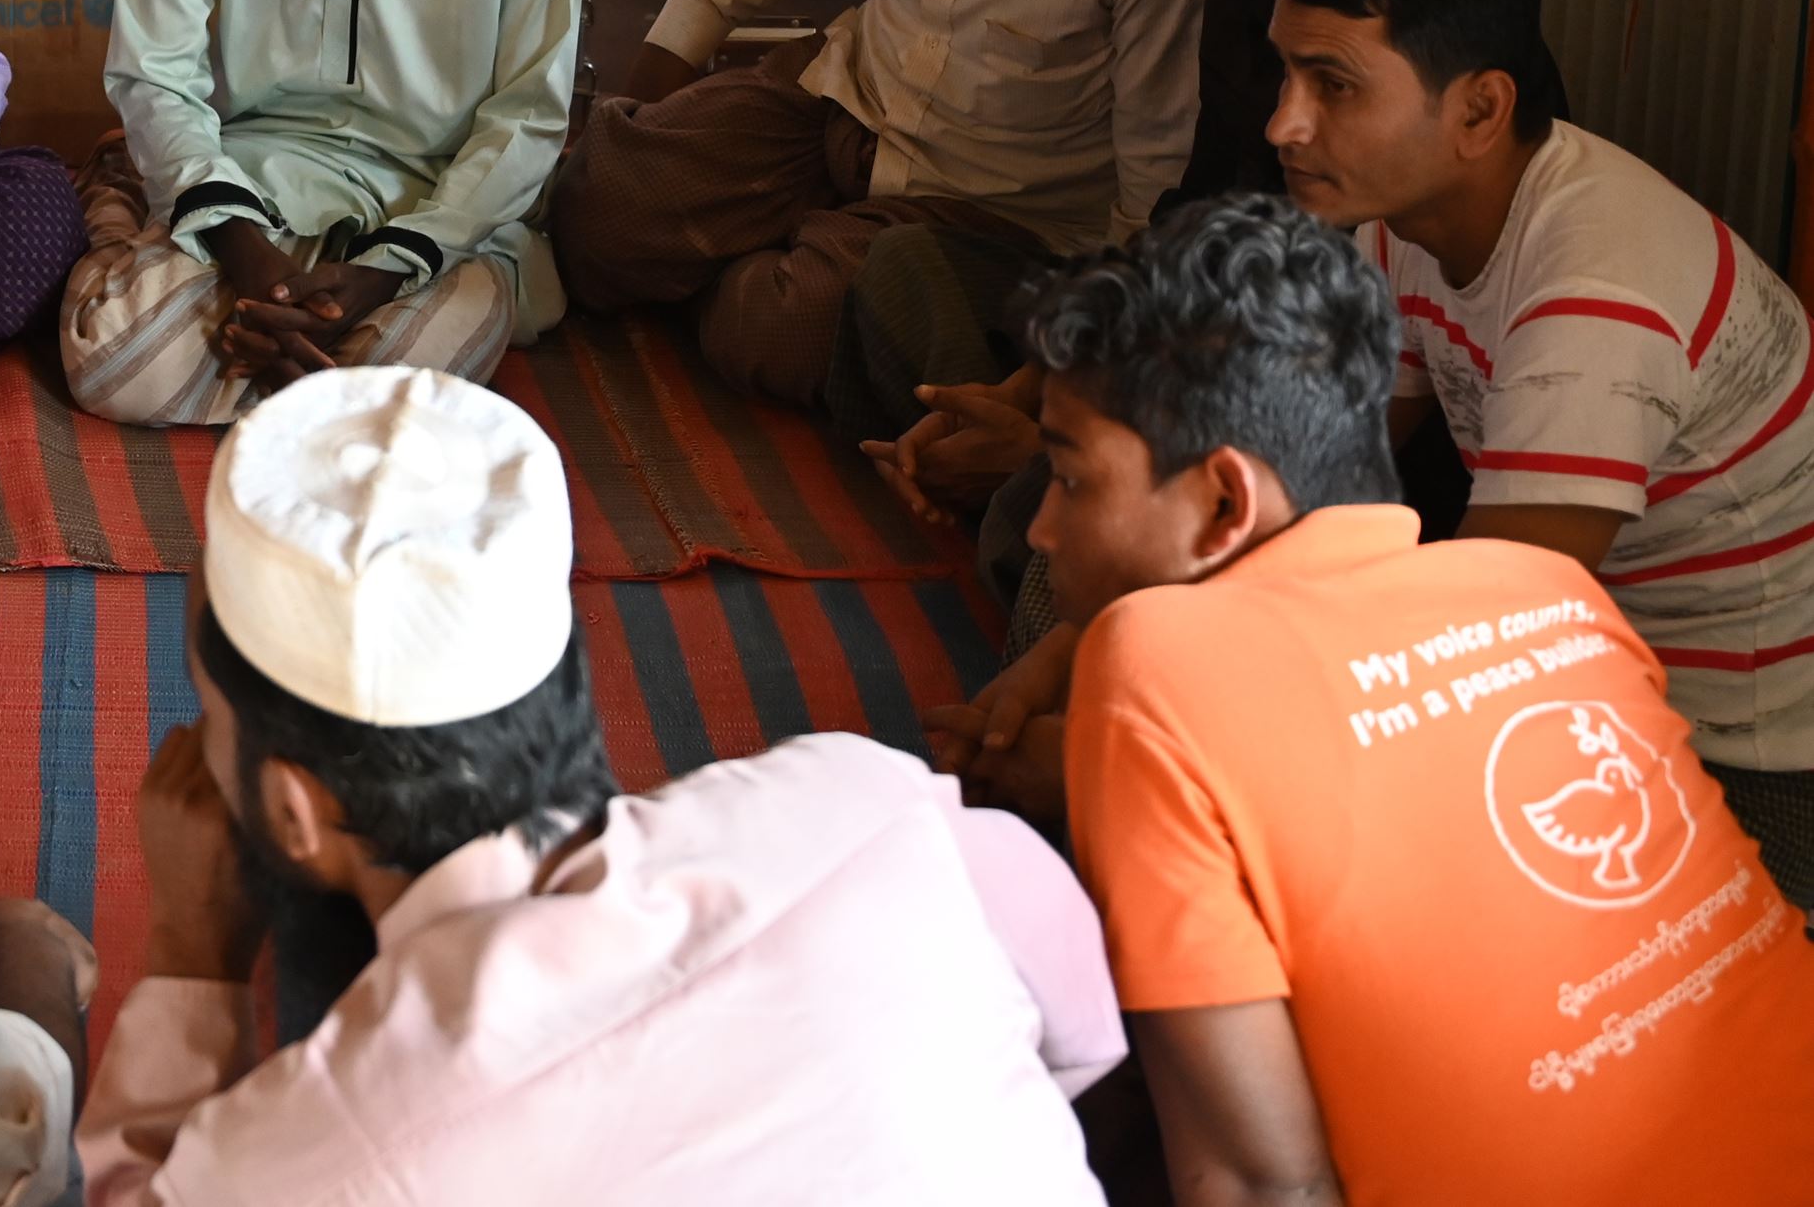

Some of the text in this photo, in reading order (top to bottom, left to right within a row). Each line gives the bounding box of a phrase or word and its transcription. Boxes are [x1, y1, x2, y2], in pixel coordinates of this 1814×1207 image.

[1348, 598, 1596, 693] My voice counts.
[1421, 689, 1450, 719] a
[1450, 657, 1535, 713] peace
